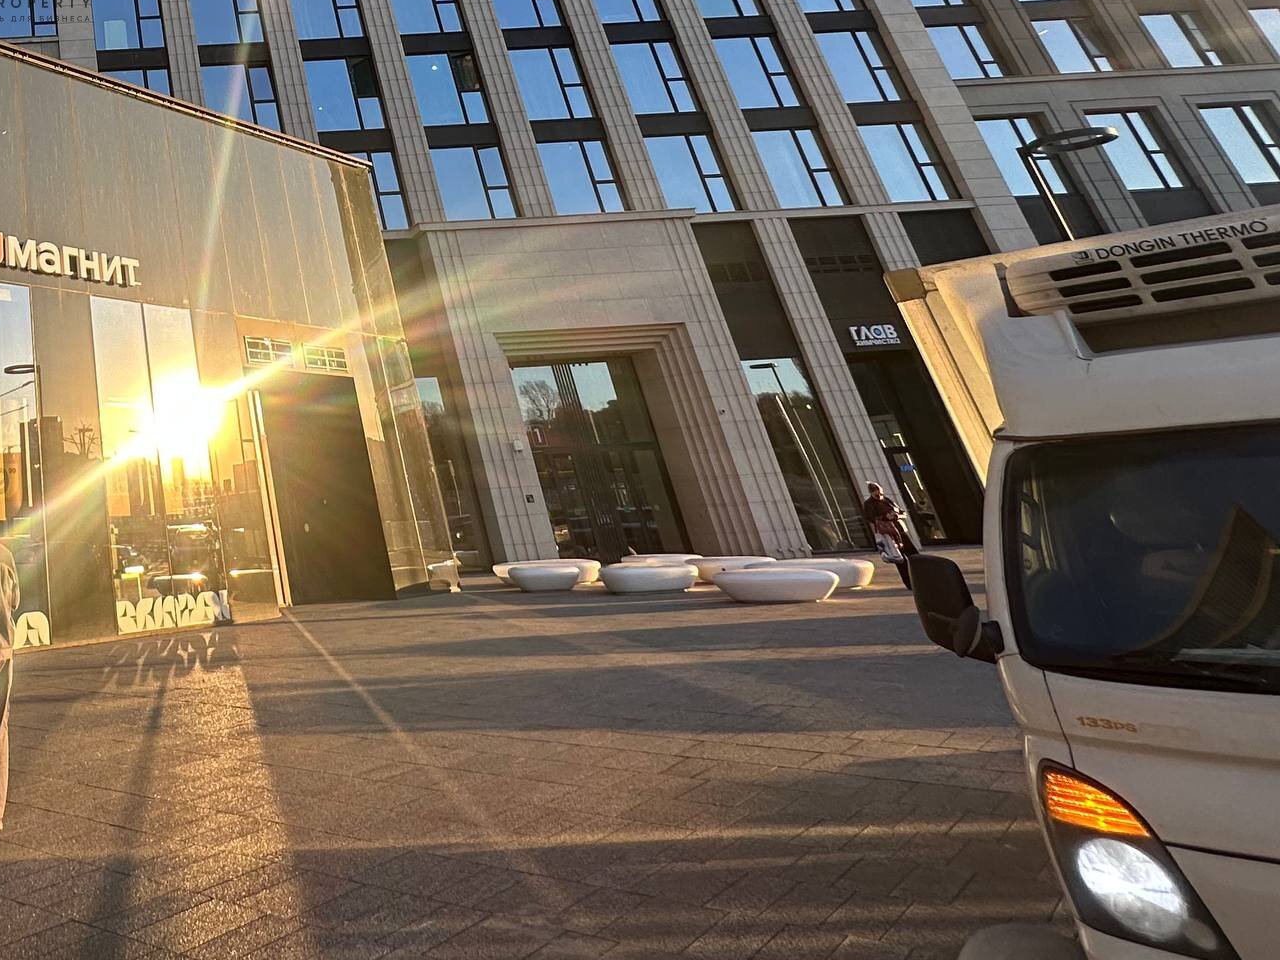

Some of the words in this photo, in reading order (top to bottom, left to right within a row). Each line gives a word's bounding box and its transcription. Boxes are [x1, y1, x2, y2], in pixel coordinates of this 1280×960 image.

[1094, 236, 1176, 259] DONGIN
[1178, 220, 1269, 245] THERMO
[1076, 716, 1137, 732] 133PS
